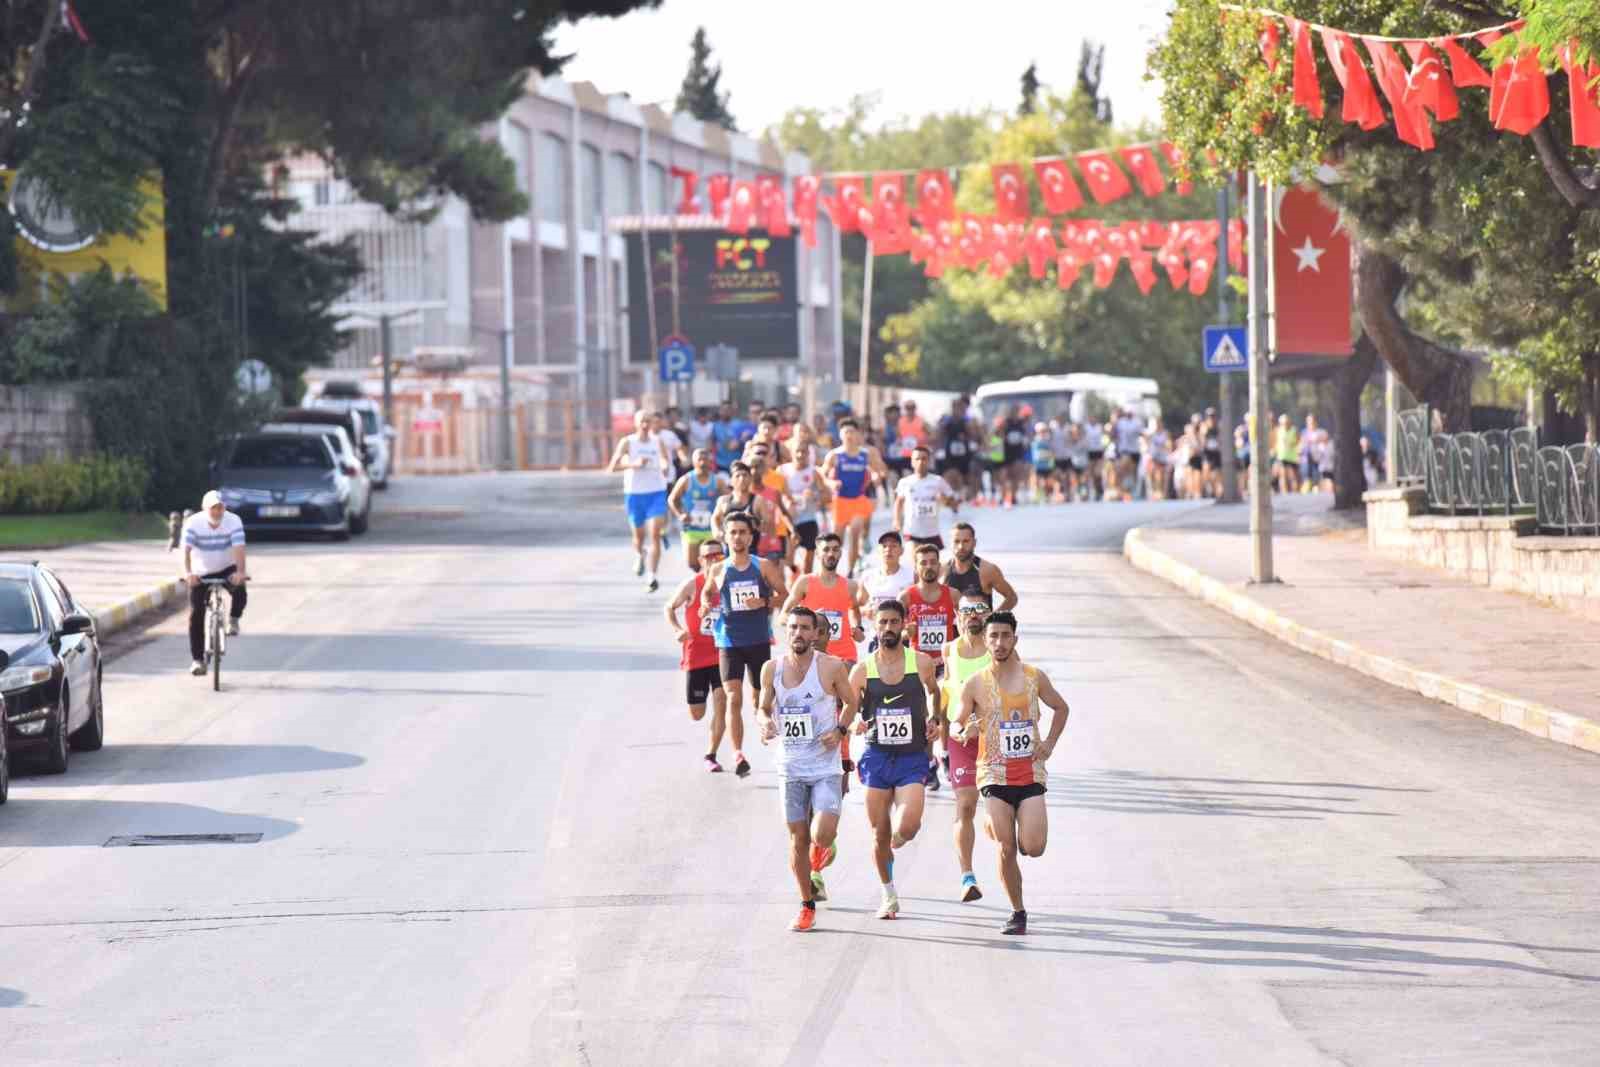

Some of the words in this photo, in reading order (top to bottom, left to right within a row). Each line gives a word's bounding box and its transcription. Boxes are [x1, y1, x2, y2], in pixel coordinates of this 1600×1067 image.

[666, 351, 686, 379] P
[921, 632, 944, 644] 200
[784, 721, 806, 737] 261
[882, 722, 908, 738] 126
[1005, 734, 1031, 751] 189
